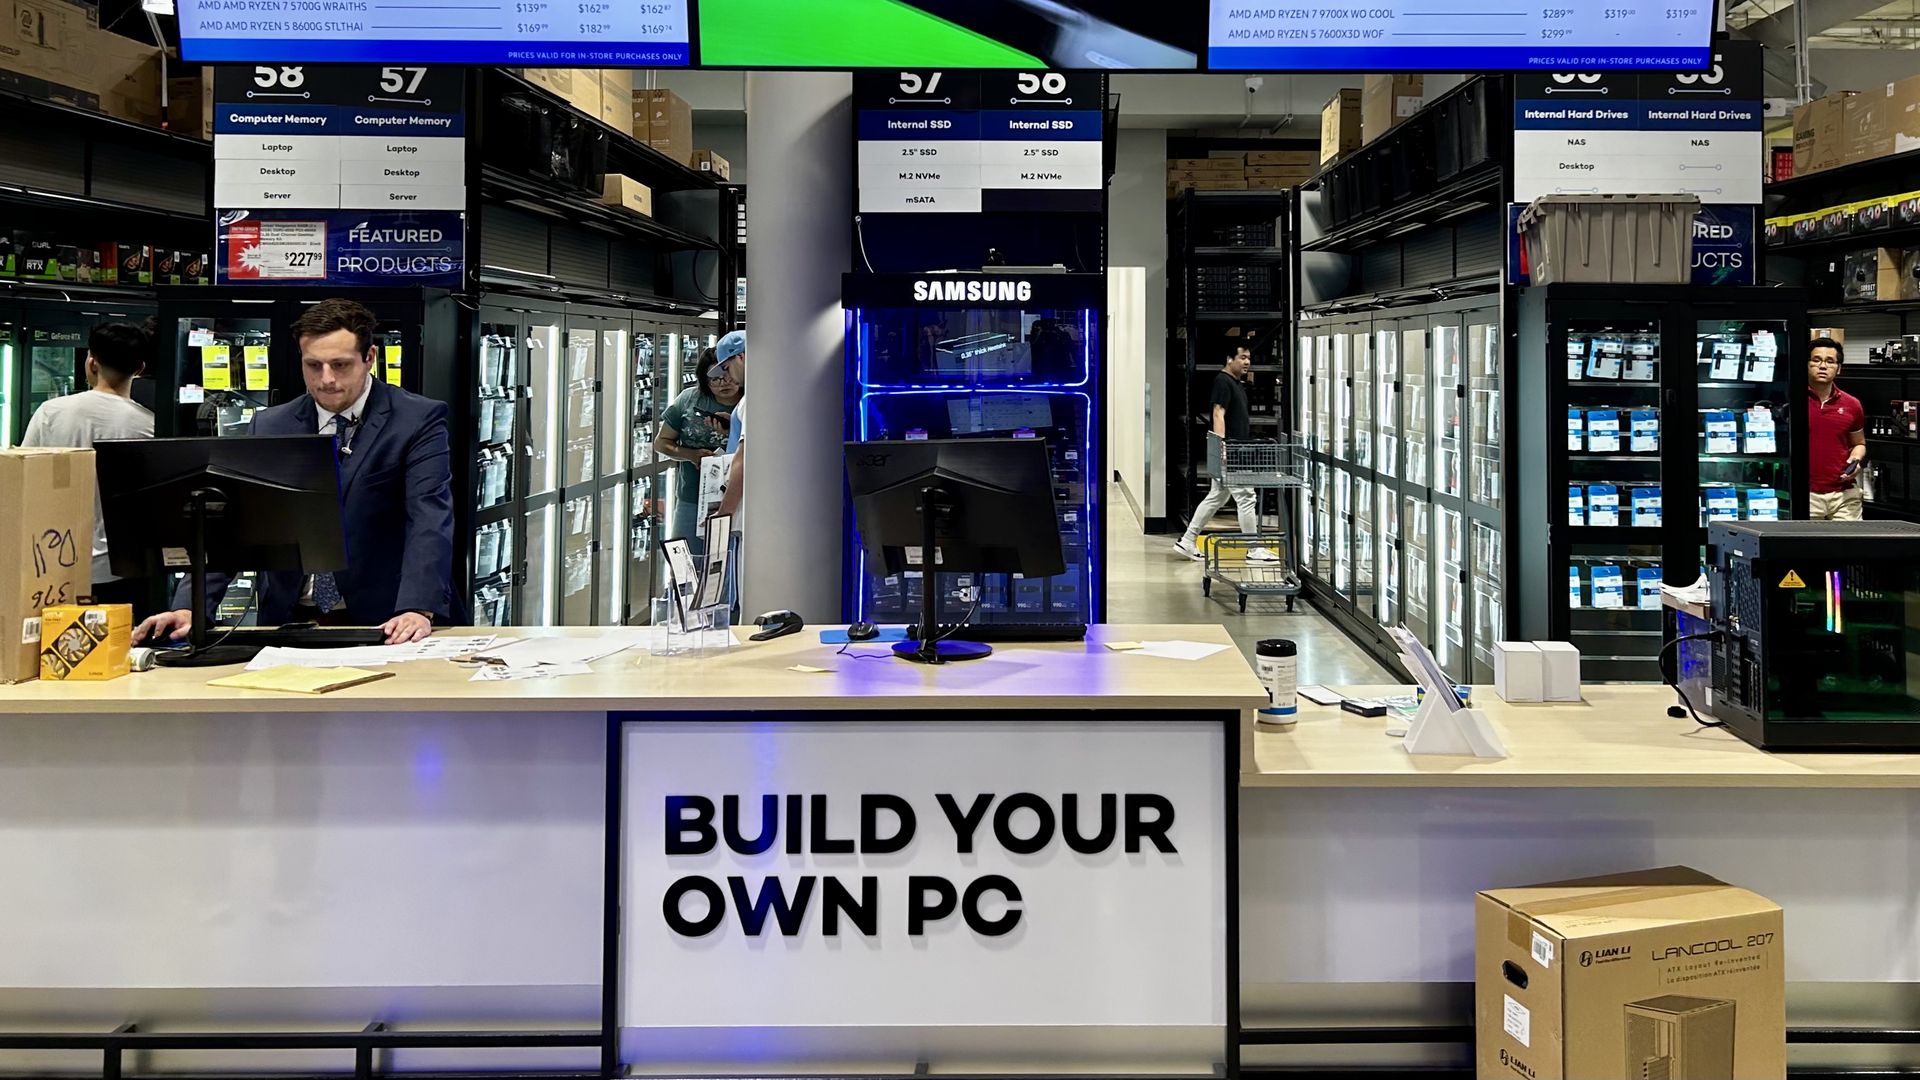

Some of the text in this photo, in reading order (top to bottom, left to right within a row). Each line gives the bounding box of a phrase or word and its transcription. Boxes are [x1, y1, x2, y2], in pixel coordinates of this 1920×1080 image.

[198, 1, 221, 10] AMD
[224, 1, 246, 10] AMD
[249, 2, 280, 11] RYZEN
[283, 2, 288, 11] 7
[291, 2, 321, 11] 5700G
[323, 2, 367, 11] WRAITHS
[1228, 9, 1251, 19] AMD
[1253, 9, 1276, 19] AMD
[1278, 9, 1309, 19] RYZEN
[1312, 9, 1317, 19] 7
[1319, 9, 1348, 19] 9700X
[1350, 9, 1367, 19] WO
[1369, 9, 1395, 19] COOL
[200, 21, 223, 31] AMD
[225, 21, 248, 31] AMD
[251, 22, 282, 31] RYZEN
[284, 22, 289, 31] 5
[292, 22, 322, 31] 8600G
[325, 22, 363, 31] STLTHAI
[1228, 29, 1250, 39] AMD
[1252, 29, 1275, 39] AMD
[1277, 29, 1308, 39] RYZEN
[1311, 29, 1316, 39] 5
[1318, 29, 1360, 39] 7600X3D
[1362, 29, 1384, 39] WOF
[578, 52, 613, 60] IN-STORE
[662, 53, 682, 61] ONLY
[1528, 57, 1702, 65] PRICES VALID FOR IN-STORE PURCHASES ONLY
[380, 67, 428, 94] 57
[1524, 110, 1629, 119] Internal Hard Drives
[1648, 110, 1752, 120] Internal Hard Drives
[230, 114, 328, 126] Computer Memory
[354, 115, 452, 128] Computer Memory
[888, 120, 952, 129] Internal SSD
[1009, 120, 1074, 130] Internal SSD
[1568, 138, 1586, 146] NAS
[262, 144, 293, 152] Laptop
[386, 145, 418, 154] Laptop
[902, 148, 918, 156] 2.5"
[1024, 148, 1040, 156] 2.5"
[1559, 162, 1595, 171] Desktop
[260, 168, 296, 176] Desktop
[384, 169, 420, 178] Desktop
[906, 196, 936, 204] mSATA
[349, 229, 443, 243] FEATURED
[284, 252, 322, 267] $22799
[338, 256, 452, 272] PRODUCTS
[1691, 252, 1742, 268] UCTS
[26, 262, 44, 271] RTX
[914, 280, 1032, 302] SAMSUNG
[664, 792, 1178, 856] BUILD YOUR
[662, 874, 1023, 938] OWN PC
[1652, 938, 1742, 960] LANCOOL
[1747, 932, 1774, 947] 207
[1596, 946, 1632, 958] LIAN LI
[1510, 1056, 1527, 1072] LIAN
[1528, 1068, 1536, 1078] LI
